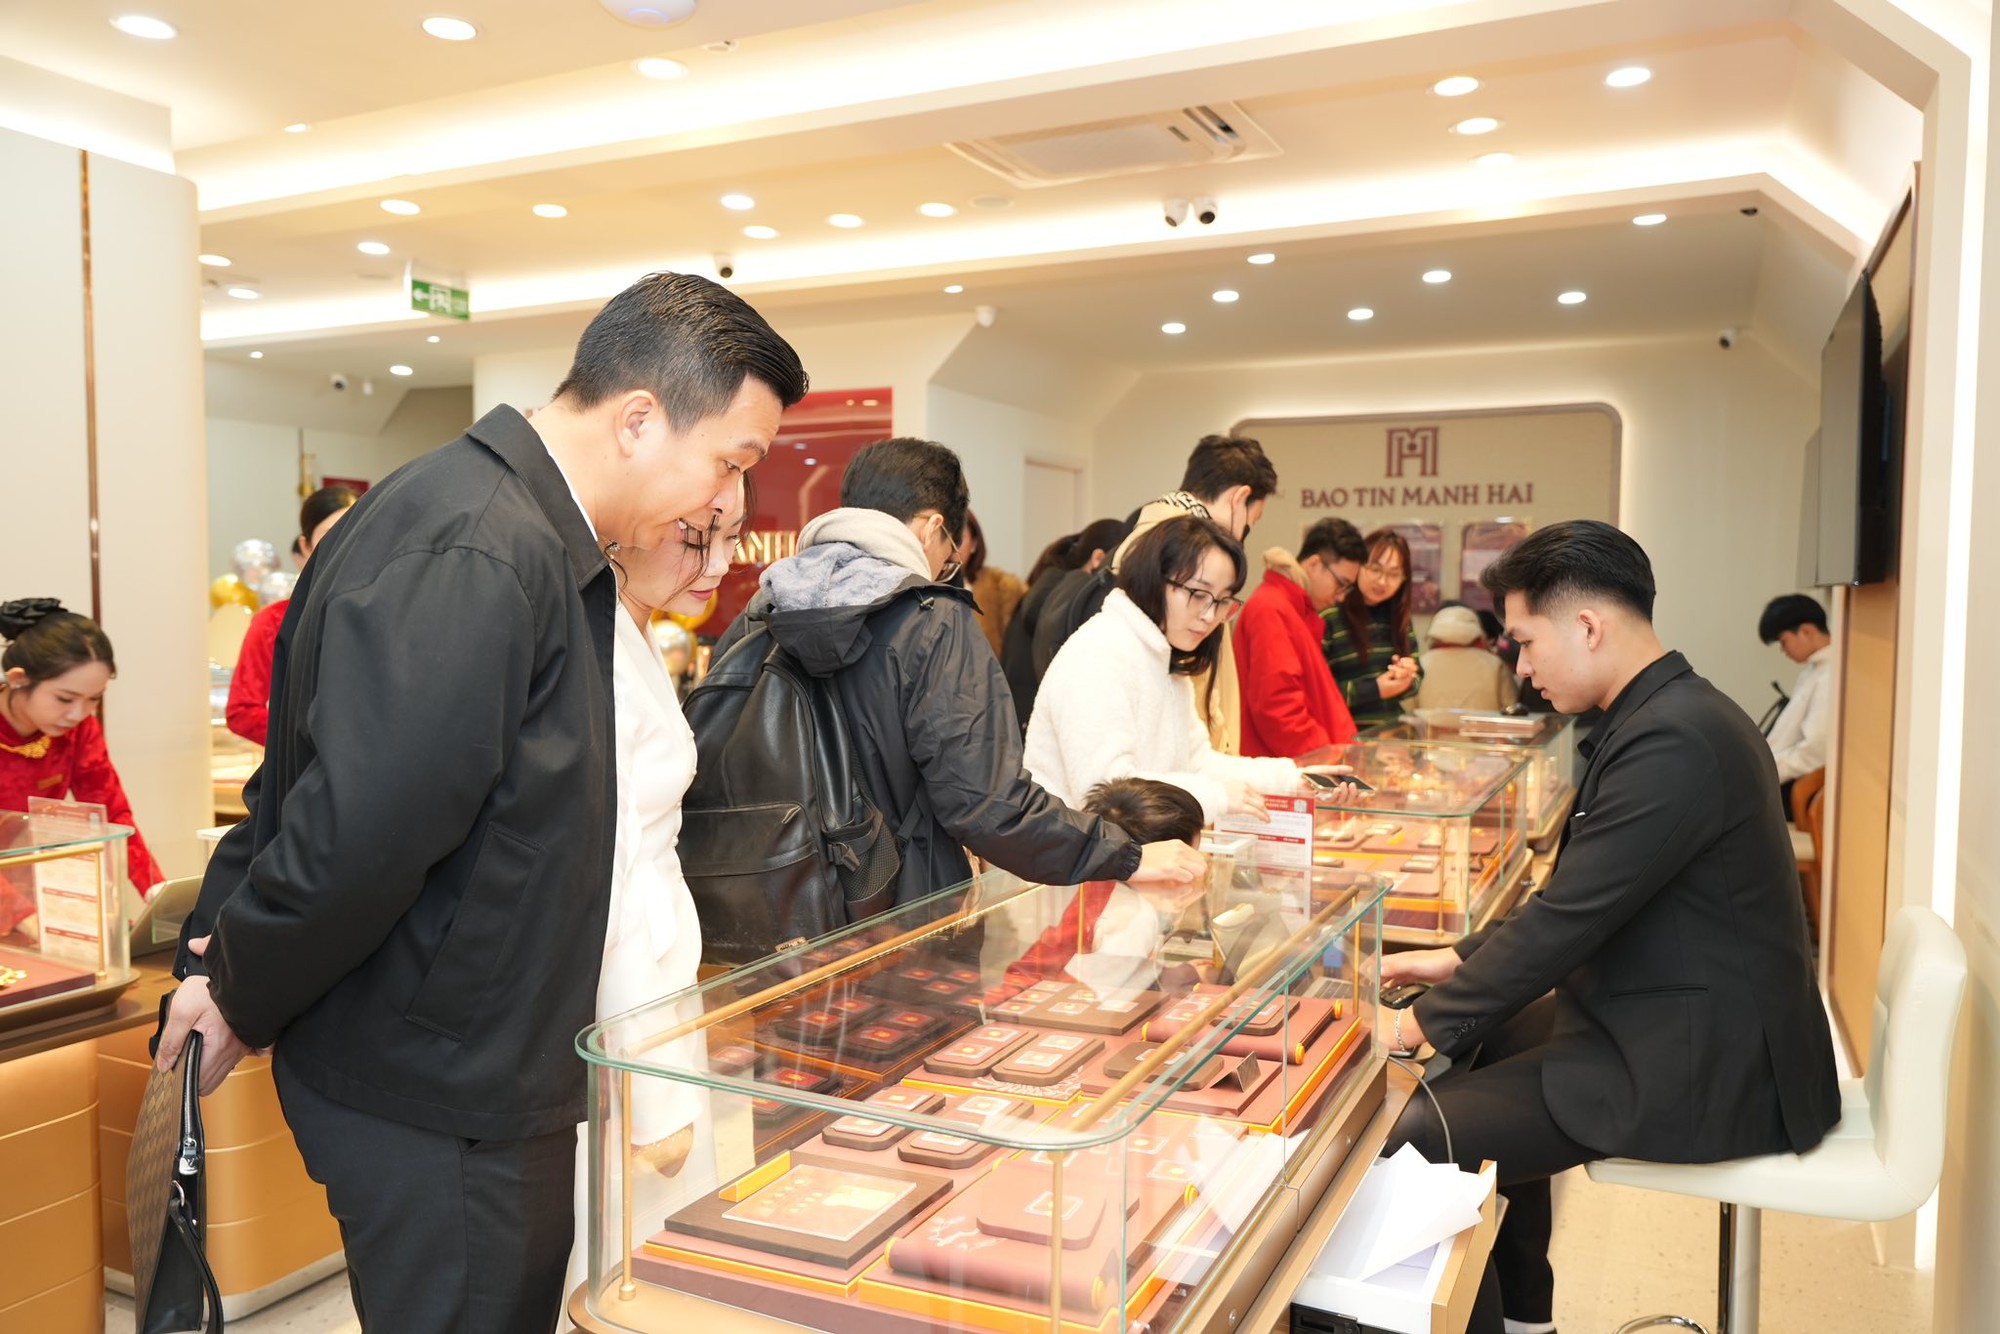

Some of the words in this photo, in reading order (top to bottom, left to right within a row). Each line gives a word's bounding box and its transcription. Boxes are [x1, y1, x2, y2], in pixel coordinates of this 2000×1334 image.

[1301, 487, 1349, 508] BAO
[1353, 486, 1396, 507] TIN
[1401, 484, 1479, 506] MANH
[1487, 482, 1533, 505] HAI
